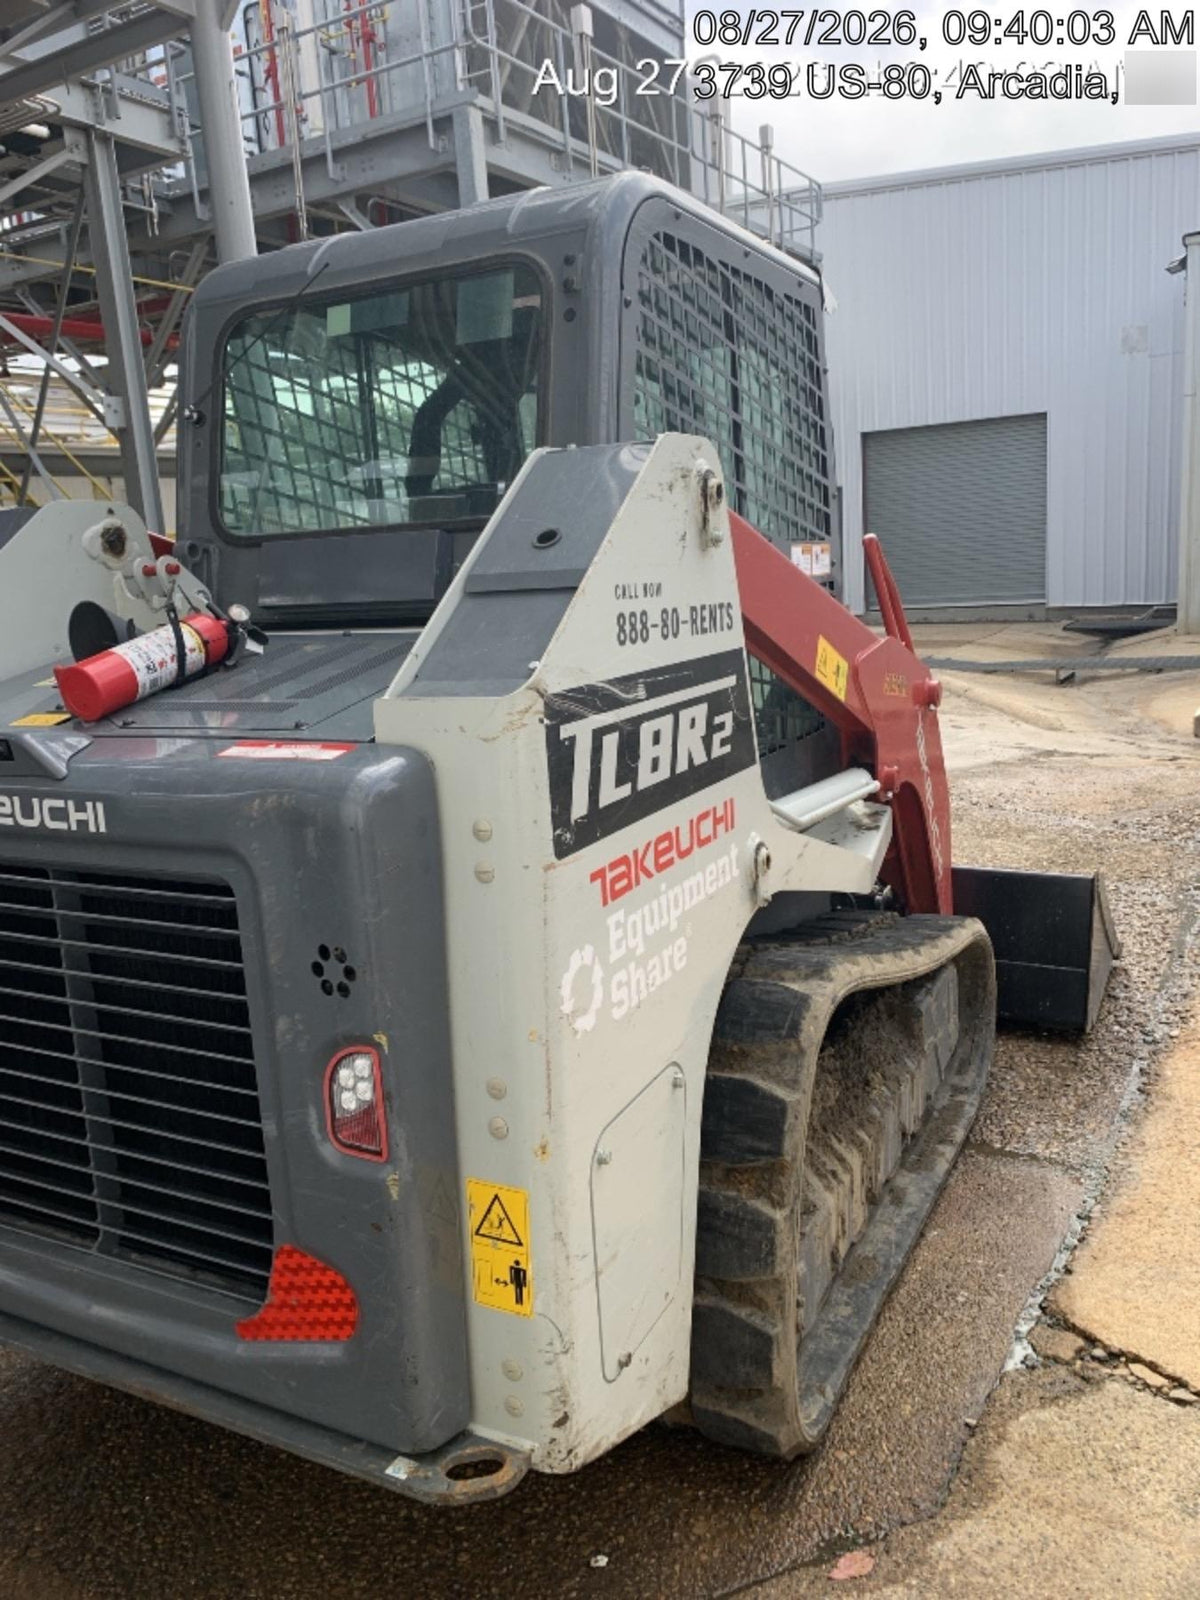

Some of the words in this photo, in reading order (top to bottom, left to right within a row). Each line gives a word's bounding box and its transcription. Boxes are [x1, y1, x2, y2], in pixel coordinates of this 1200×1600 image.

[614, 583, 640, 600] CALL
[616, 601, 734, 647] 888-80-RENTS
[589, 798, 736, 908] TAKEUCHI
[606, 843, 741, 964] Equipment
[610, 935, 689, 1021] Share
